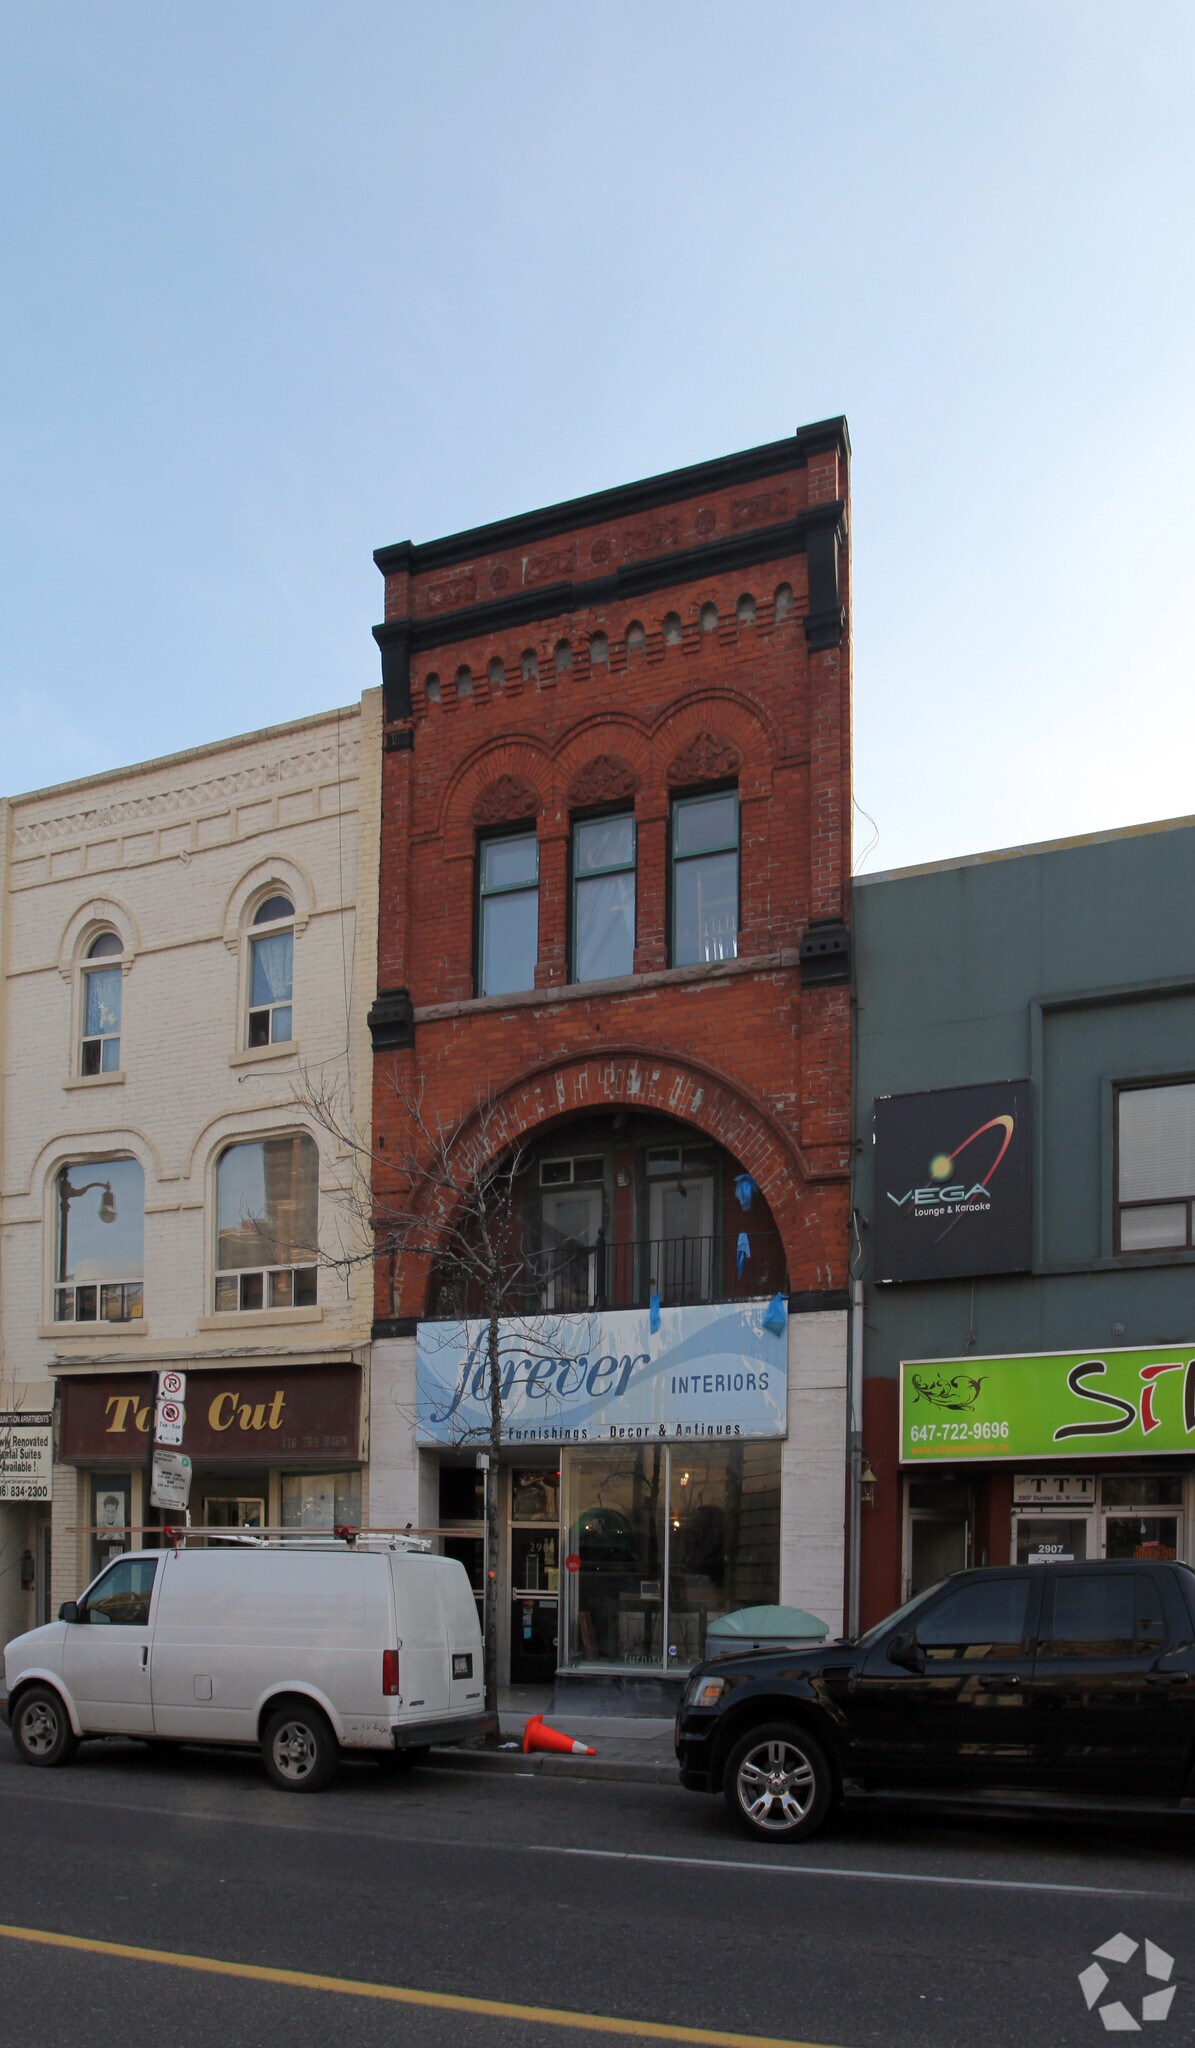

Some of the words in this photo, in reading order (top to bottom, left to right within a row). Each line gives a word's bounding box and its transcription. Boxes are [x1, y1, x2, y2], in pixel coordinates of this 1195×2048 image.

[887, 1183, 991, 1207] VEGA
[914, 1207, 945, 1217] Lounge
[947, 1205, 953, 1213] &
[955, 1202, 991, 1213] Karaoke
[430, 1325, 651, 1424] forever
[671, 1372, 770, 1395] INTERIORS
[208, 1391, 286, 1431] Cut
[21, 1415, 50, 1424] APARTMENTS
[508, 1427, 588, 1441] Furnishings
[610, 1424, 650, 1438] Decor
[658, 1423, 667, 1436] &
[910, 1421, 1009, 1441] 647-722-9696
[12, 1436, 49, 1447] Renovated
[19, 1449, 41, 1460] Suites
[10, 1486, 48, 1497] 834-2300
[1038, 1544, 1064, 1553] 2907
